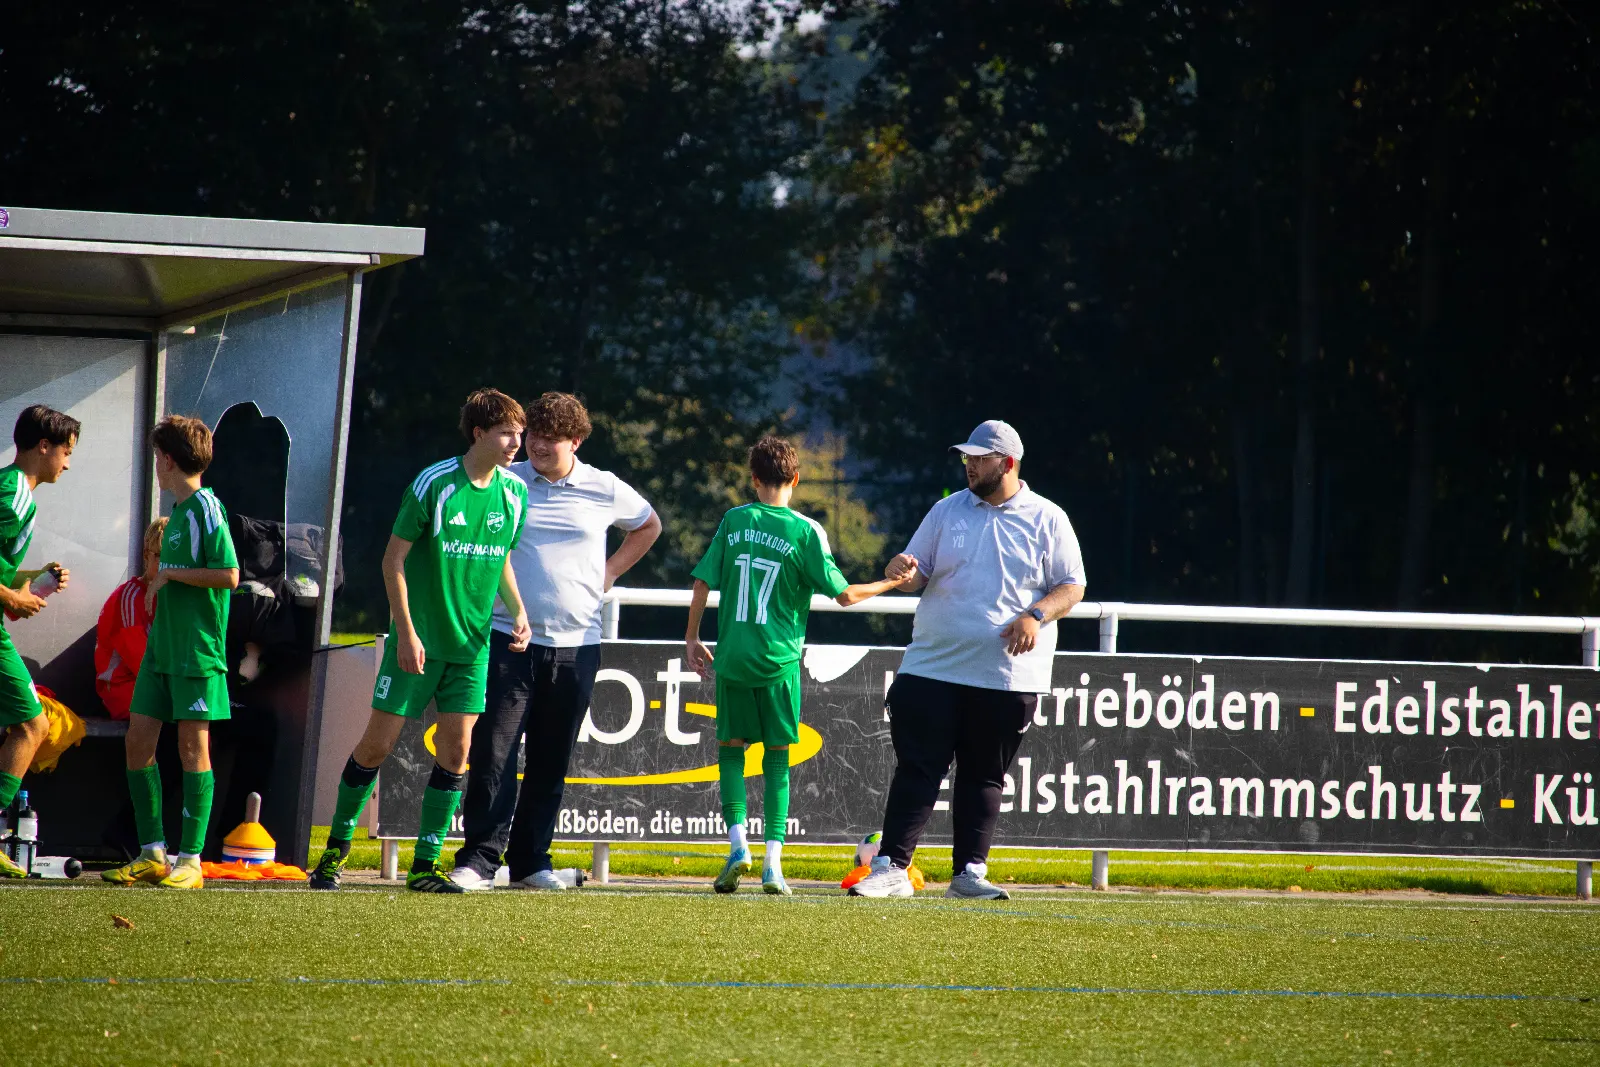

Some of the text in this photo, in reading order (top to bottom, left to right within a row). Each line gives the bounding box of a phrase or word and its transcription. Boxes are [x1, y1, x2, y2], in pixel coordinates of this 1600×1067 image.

[442, 539, 505, 556] WÖHRMANN
[735, 553, 781, 624] 17
[884, 671, 1600, 740] trieböden Edelstahle
[933, 757, 1482, 822] elstahlrammschutz
[554, 808, 645, 838] ßböden,
[650, 810, 683, 834] die
